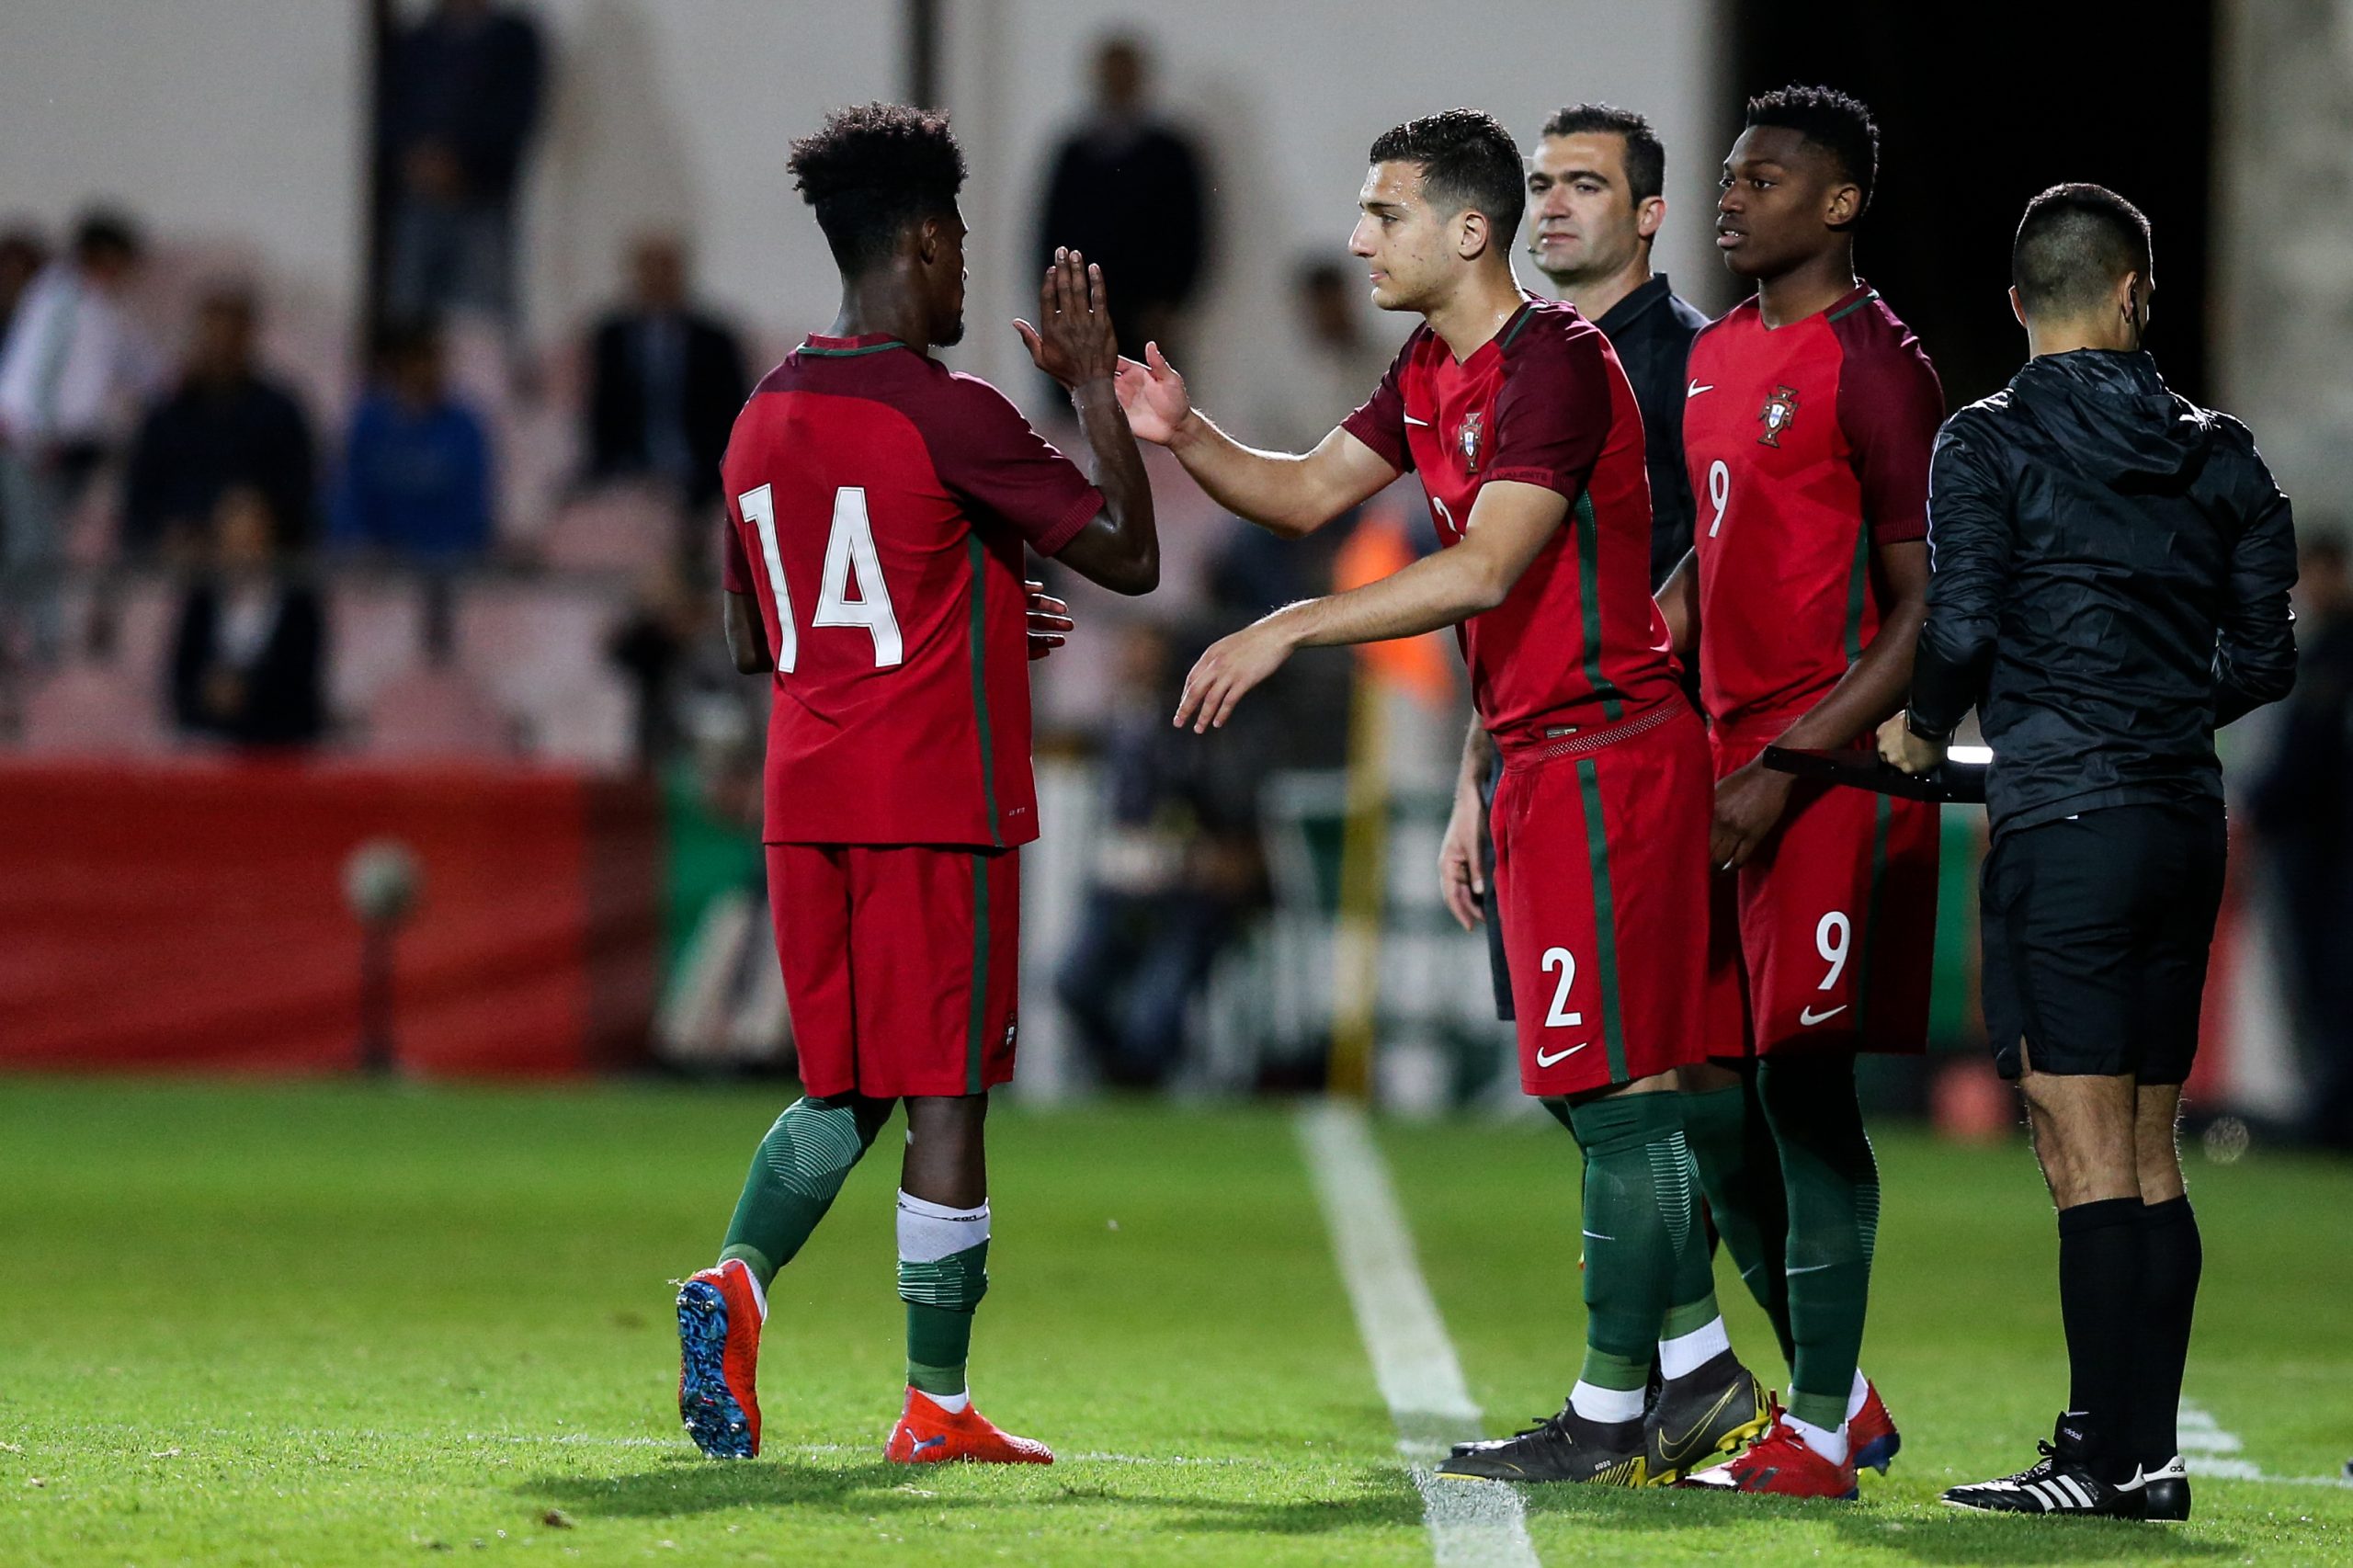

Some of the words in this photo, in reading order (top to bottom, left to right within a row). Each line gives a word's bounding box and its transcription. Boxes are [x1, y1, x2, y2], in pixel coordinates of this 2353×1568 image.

[1709, 460, 1729, 538] 9
[738, 483, 903, 673] 14
[1540, 947, 1582, 1027] 2
[1816, 911, 1850, 990] 9
